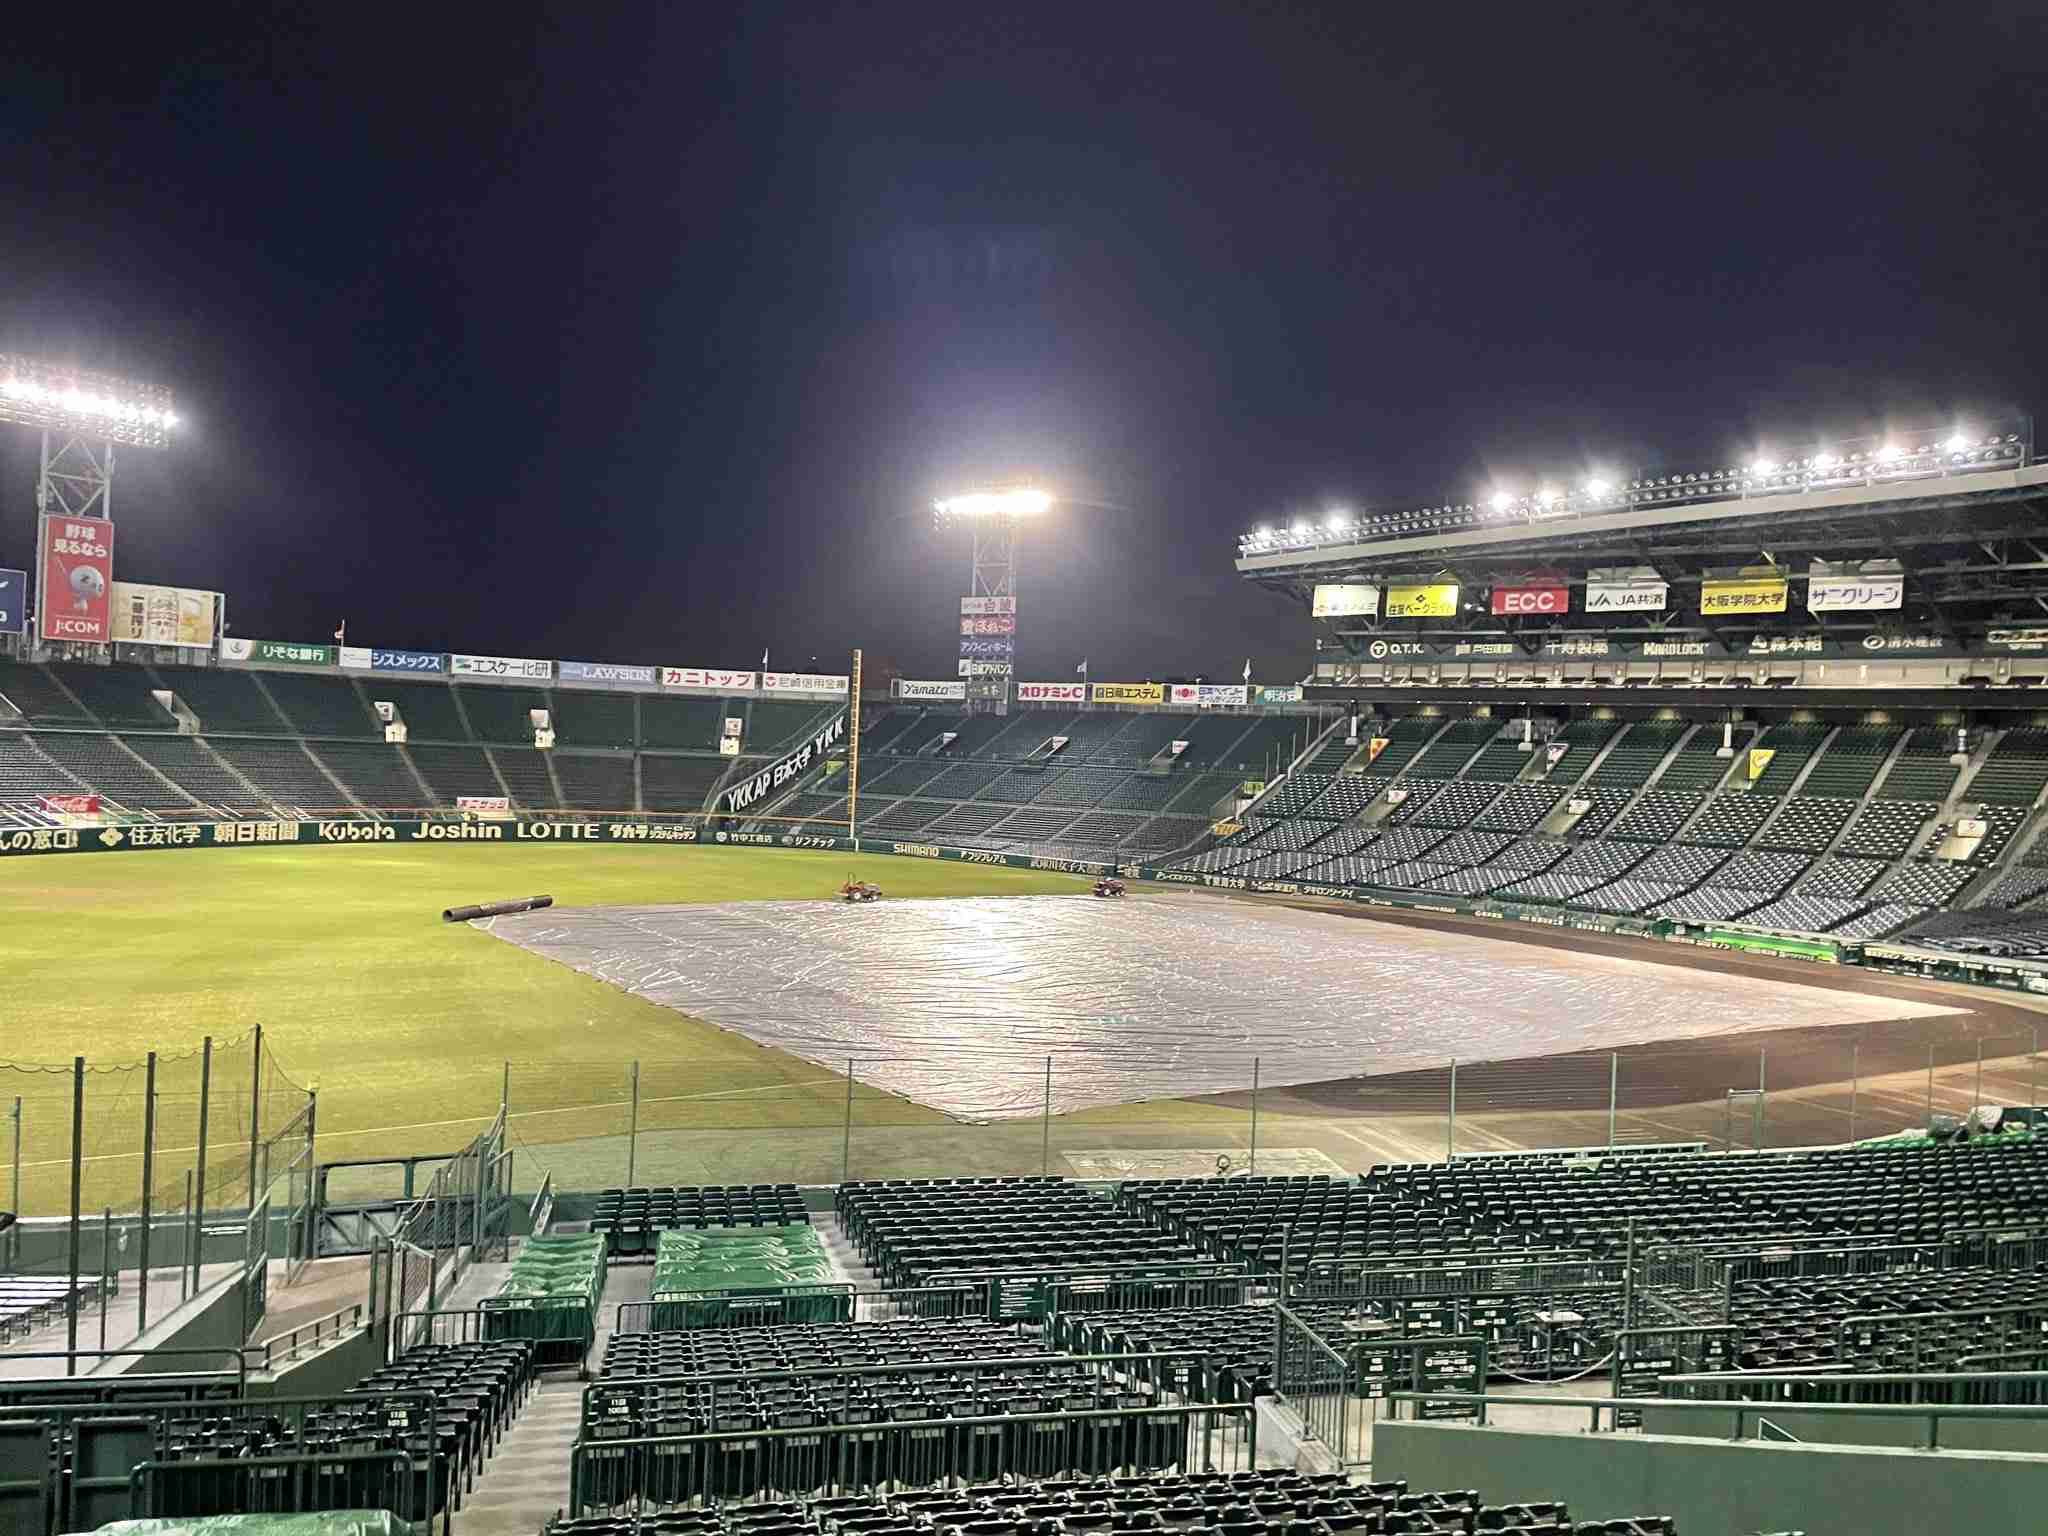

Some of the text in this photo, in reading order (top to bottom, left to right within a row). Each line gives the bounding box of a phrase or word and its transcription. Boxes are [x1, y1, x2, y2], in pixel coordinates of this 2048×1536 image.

[53, 538, 108, 558] 見るなら
[1504, 592, 1554, 611] ECC
[1615, 594, 1663, 606] JA共済
[1704, 592, 1785, 608] 大阪学院大学
[1812, 586, 1900, 606] サニクリーン
[262, 645, 325, 662] りそな銀行
[372, 652, 441, 670] シスメックス
[471, 659, 550, 678] エスケー化研
[582, 667, 654, 683] LAWSON
[666, 670, 752, 687] カニトップ
[1020, 686, 1083, 698] オロナミンC
[128, 826, 202, 846] 住友化学
[214, 822, 299, 842] 朝日新聞
[319, 822, 396, 841] Kubota
[412, 822, 502, 839] Joshin
[517, 823, 601, 839] LOTTE
[893, 843, 940, 858] SHIMANO
